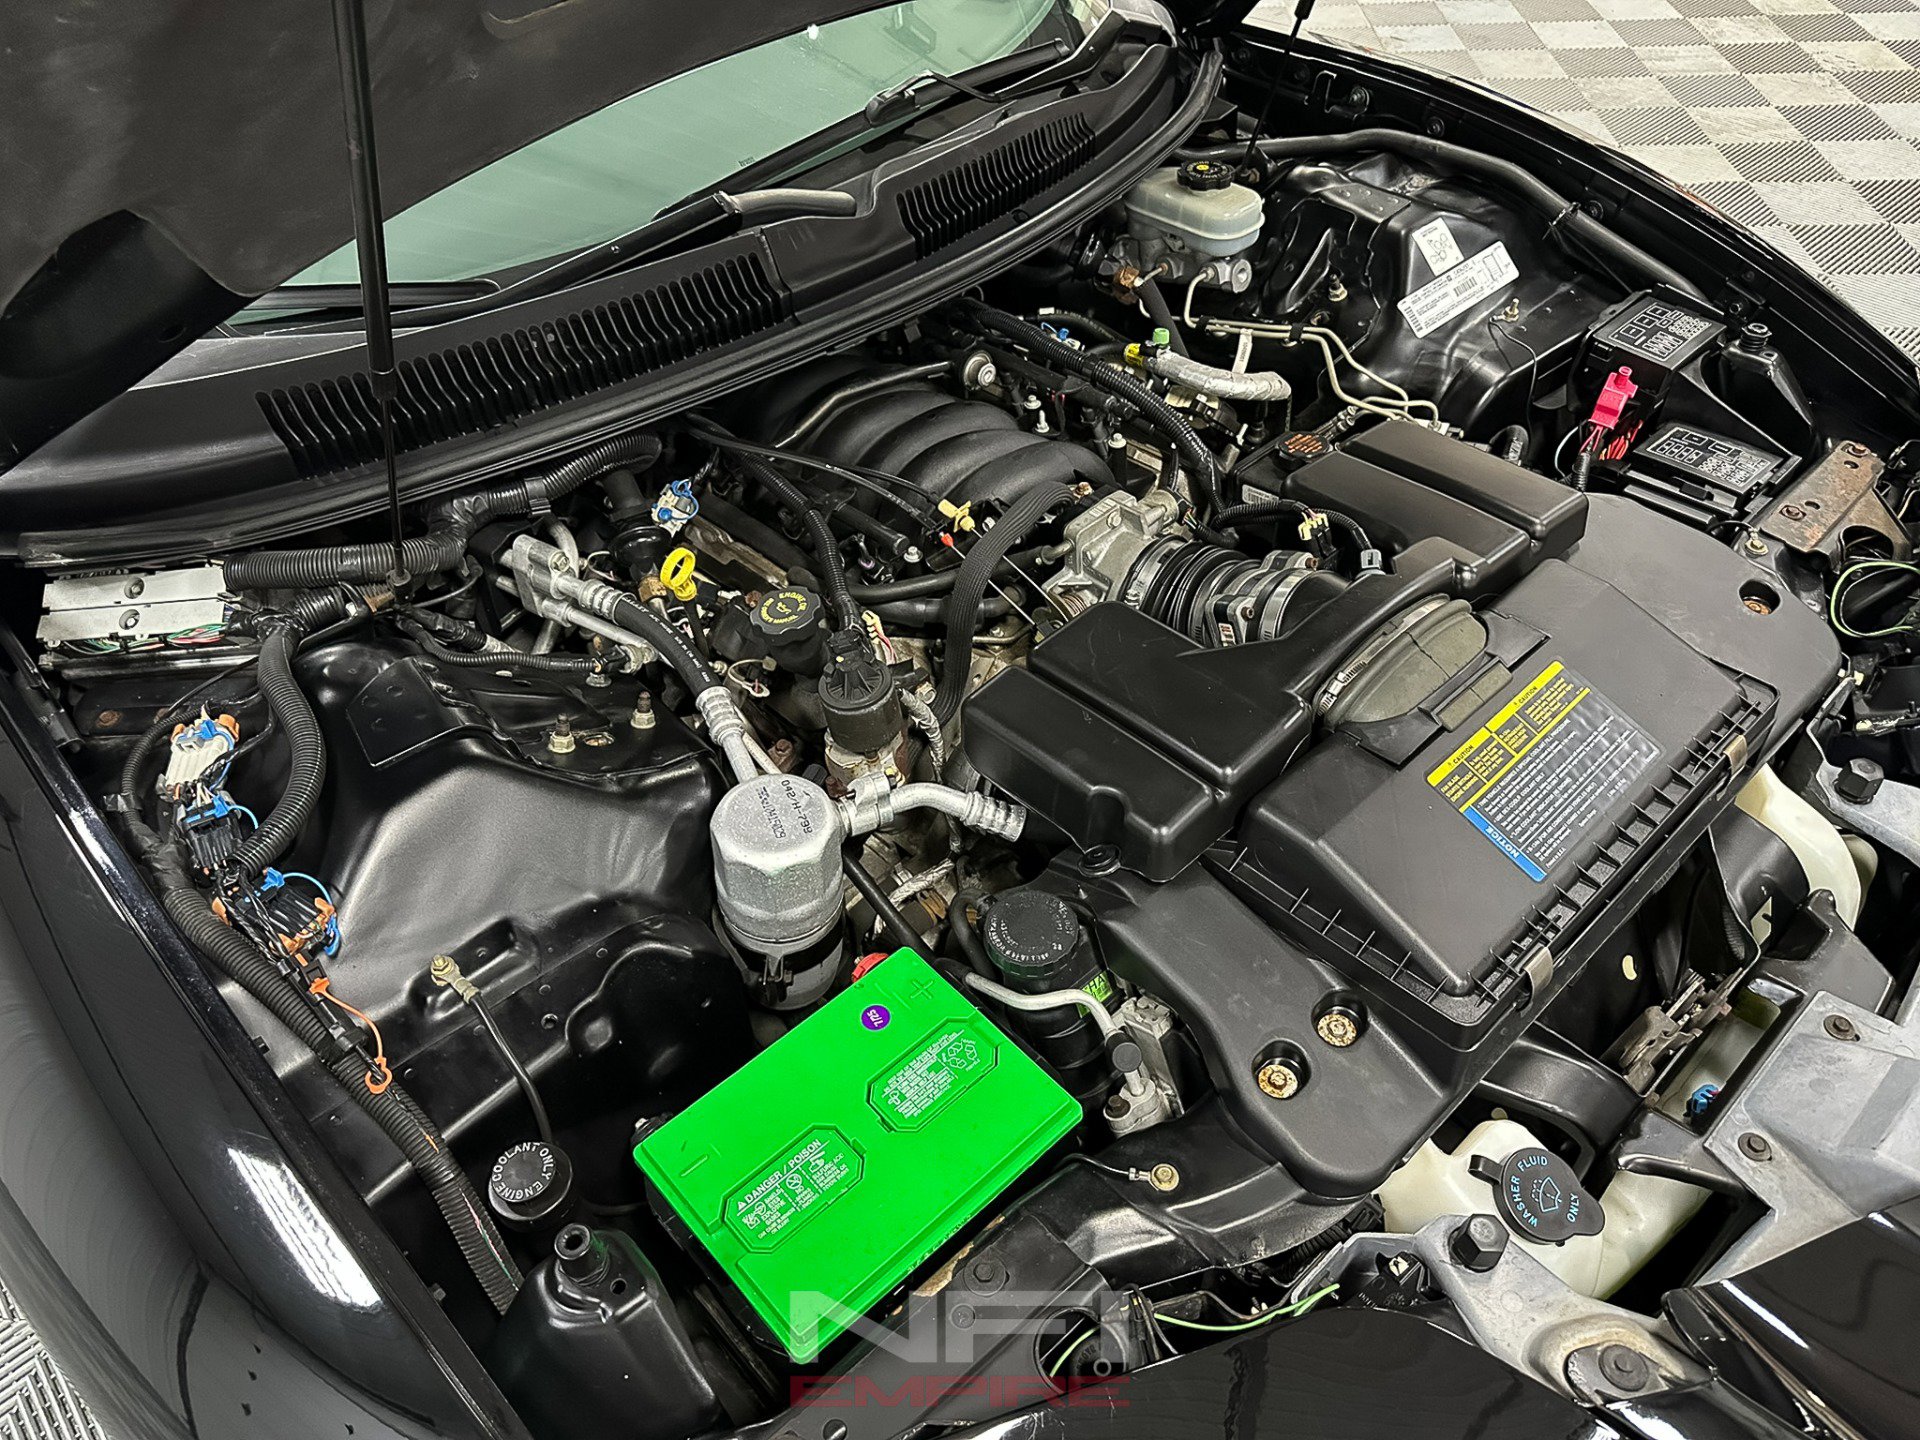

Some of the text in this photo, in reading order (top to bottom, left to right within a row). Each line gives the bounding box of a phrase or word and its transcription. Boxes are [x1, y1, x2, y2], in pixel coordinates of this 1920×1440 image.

[779, 592, 807, 612] ENGINE OIL
[1518, 686, 1537, 703] CAUTION
[1453, 745, 1474, 764] CAUTION
[1486, 785, 1501, 799] VEHICLE
[1518, 756, 1532, 769] SPECIAL
[1530, 741, 1546, 757] COOLANT
[1520, 780, 1536, 796] COOLANT
[1535, 772, 1545, 782] ONLY
[1486, 826, 1519, 857] NOTICE
[491, 1142, 554, 1200] ENGINE COOLANT ONLY
[744, 1171, 783, 1201] DANGER
[788, 1138, 822, 1168] POISON
[1510, 1155, 1580, 1227] WASHER FLUID ONLY
